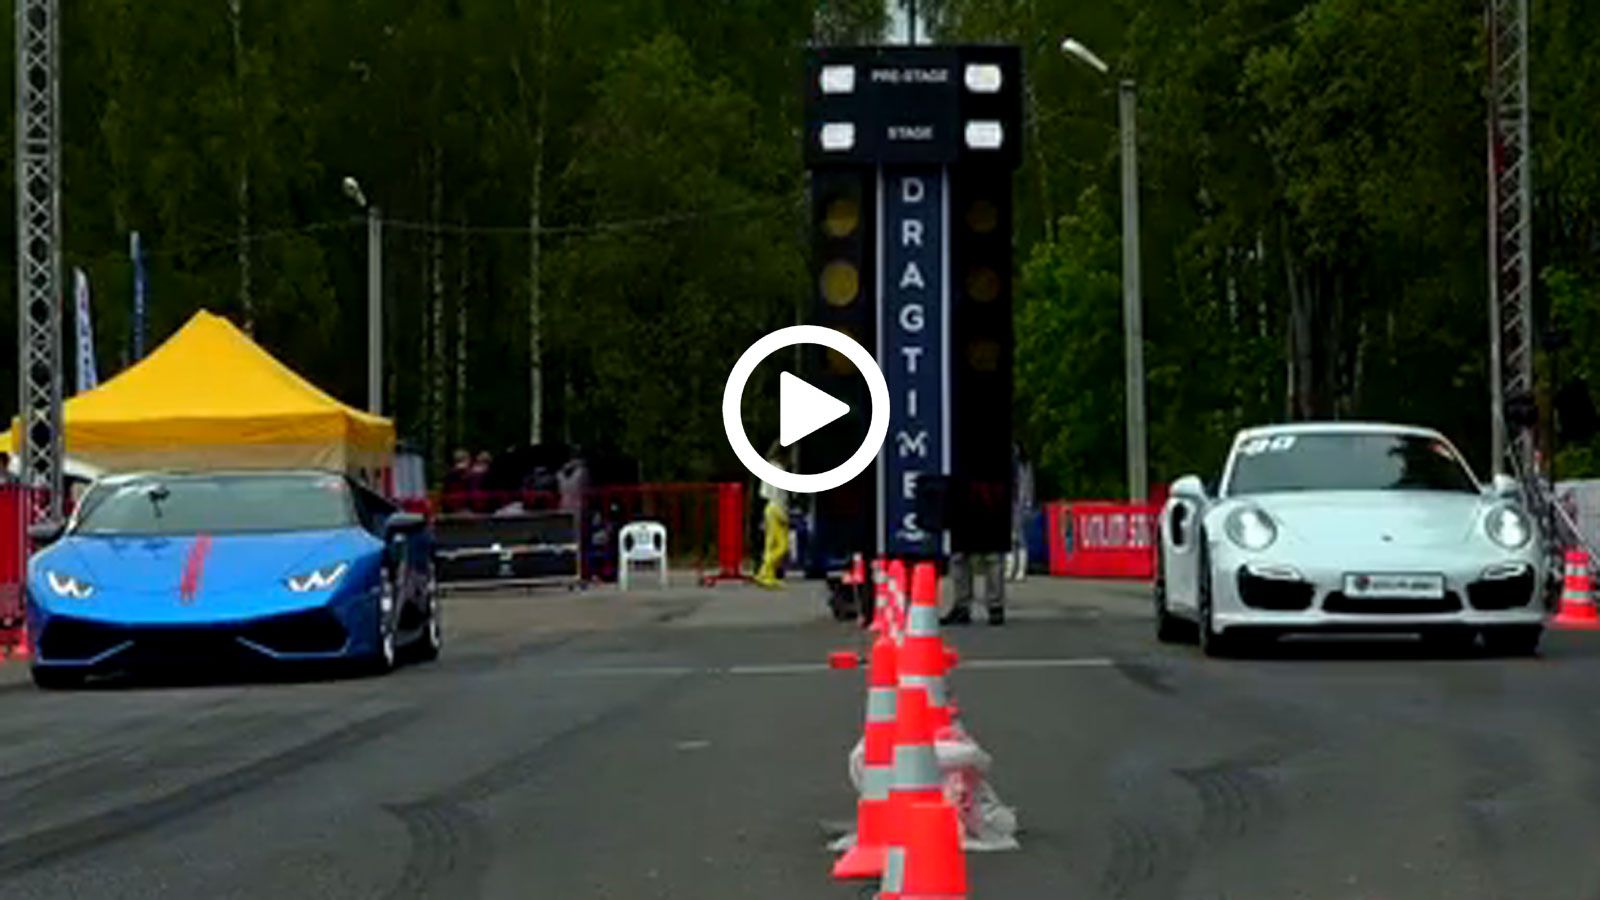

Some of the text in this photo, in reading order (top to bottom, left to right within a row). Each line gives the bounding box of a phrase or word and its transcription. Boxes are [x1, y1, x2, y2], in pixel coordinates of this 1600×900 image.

[871, 68, 949, 83] PRE-STAGE
[887, 126, 934, 140] STAGE
[898, 177, 928, 541] DRAGTIMES
